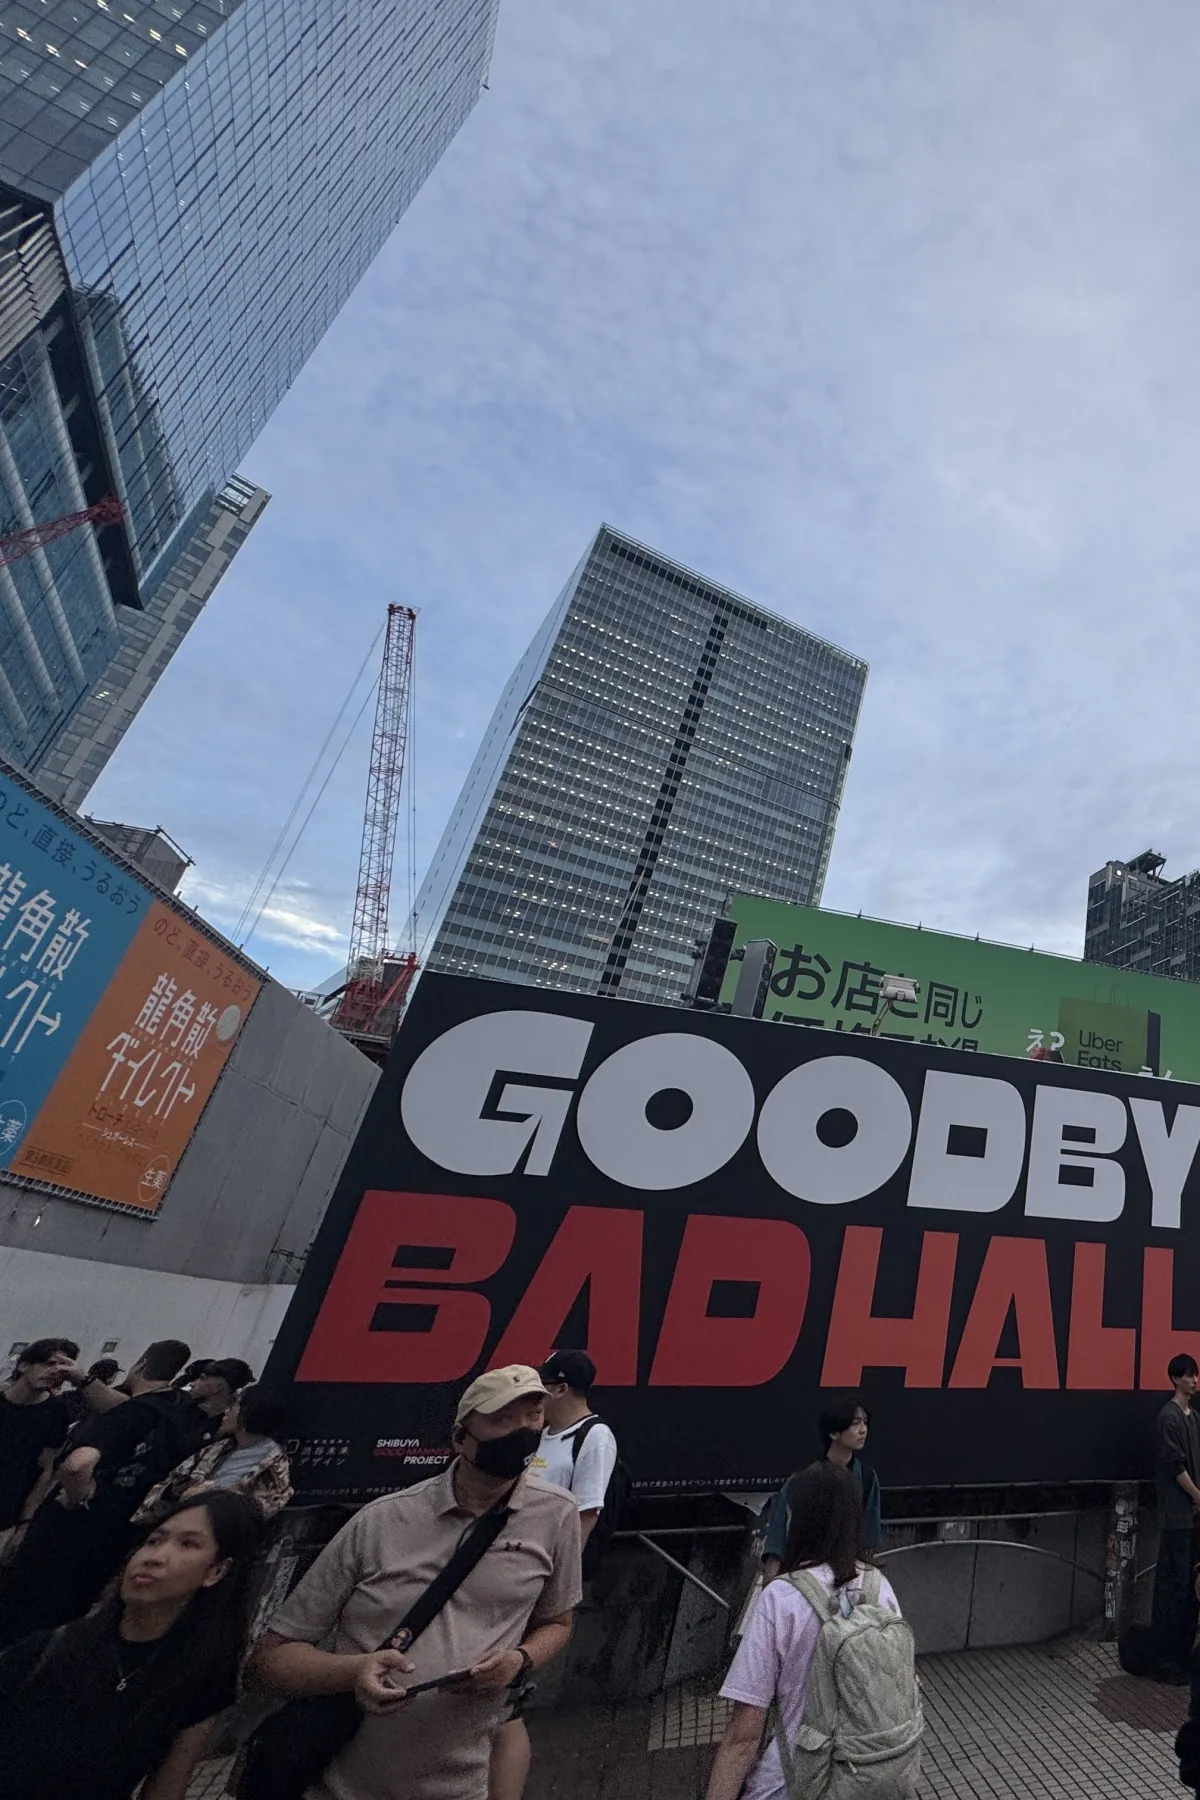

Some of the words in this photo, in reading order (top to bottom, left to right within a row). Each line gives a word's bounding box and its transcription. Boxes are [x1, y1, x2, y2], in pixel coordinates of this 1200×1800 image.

[0, 966, 61, 1054] クト
[135, 972, 218, 1059] 龍角散
[1078, 1050, 1122, 1071] Eats
[1079, 1030, 1123, 1052] Uber
[101, 1032, 195, 1119] ダイレクト
[294, 1189, 811, 1387] BAD
[376, 1439, 420, 1448] SHIBUYA
[403, 1456, 449, 1465] PROJECT
